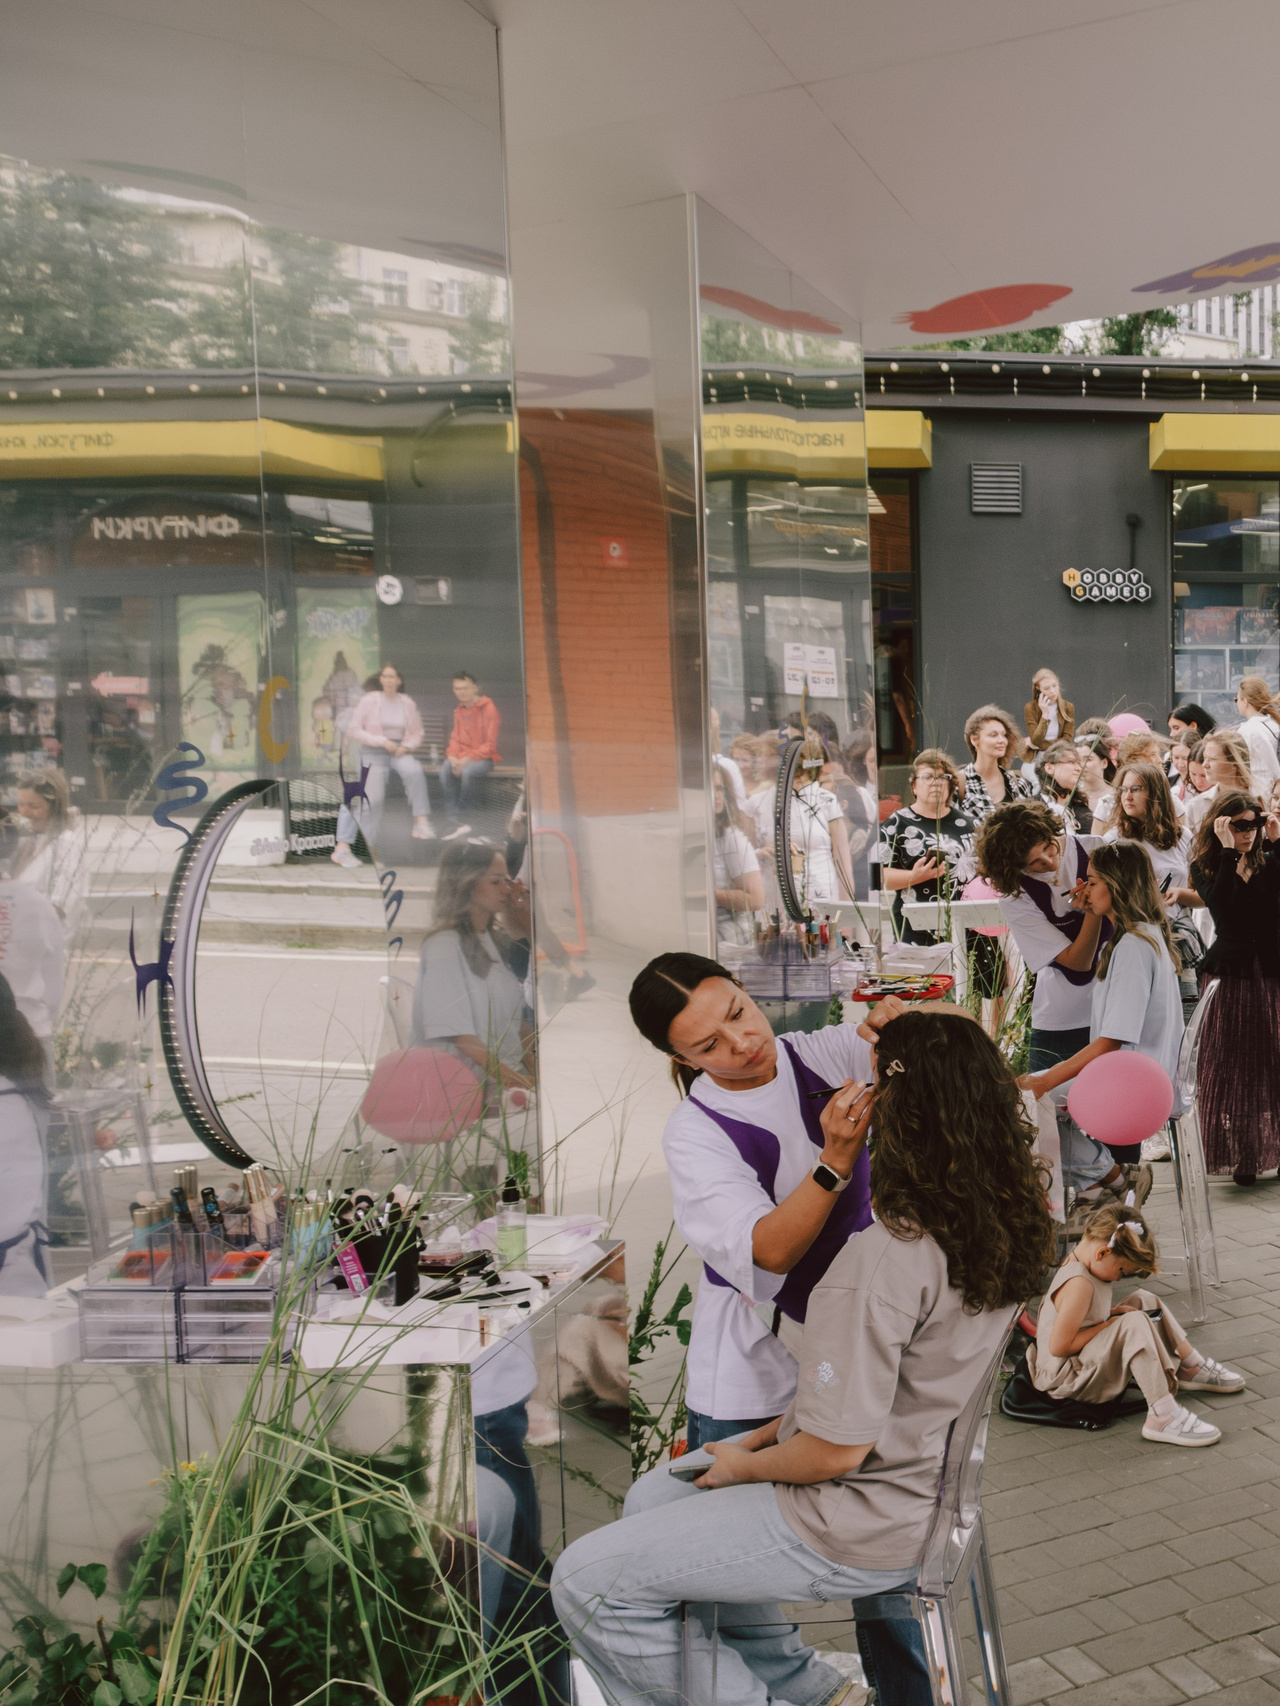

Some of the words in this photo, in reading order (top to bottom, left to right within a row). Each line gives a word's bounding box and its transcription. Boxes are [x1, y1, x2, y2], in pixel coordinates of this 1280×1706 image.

[1068, 573, 1139, 584] HOBBY
[1075, 586, 1147, 597] GAMES
[290, 834, 335, 855] Красота
